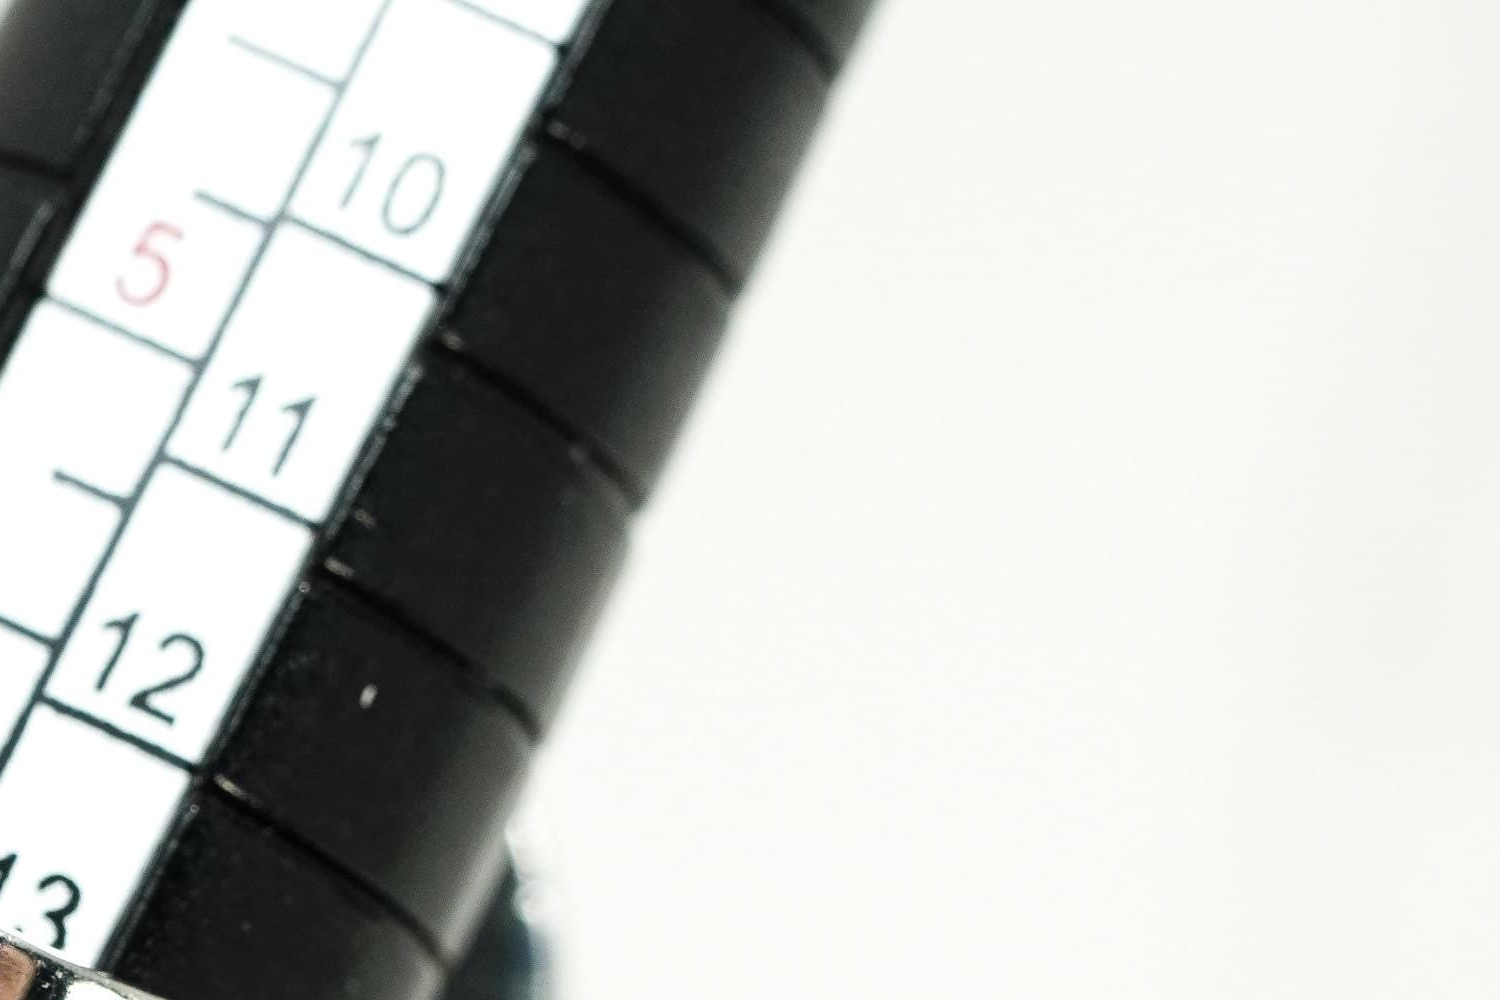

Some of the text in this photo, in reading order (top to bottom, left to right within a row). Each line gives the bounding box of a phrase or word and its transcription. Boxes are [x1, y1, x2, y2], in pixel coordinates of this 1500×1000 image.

[342, 133, 445, 236] 10
[115, 221, 184, 306] 5
[222, 375, 317, 477] 11
[96, 612, 204, 725] 12
